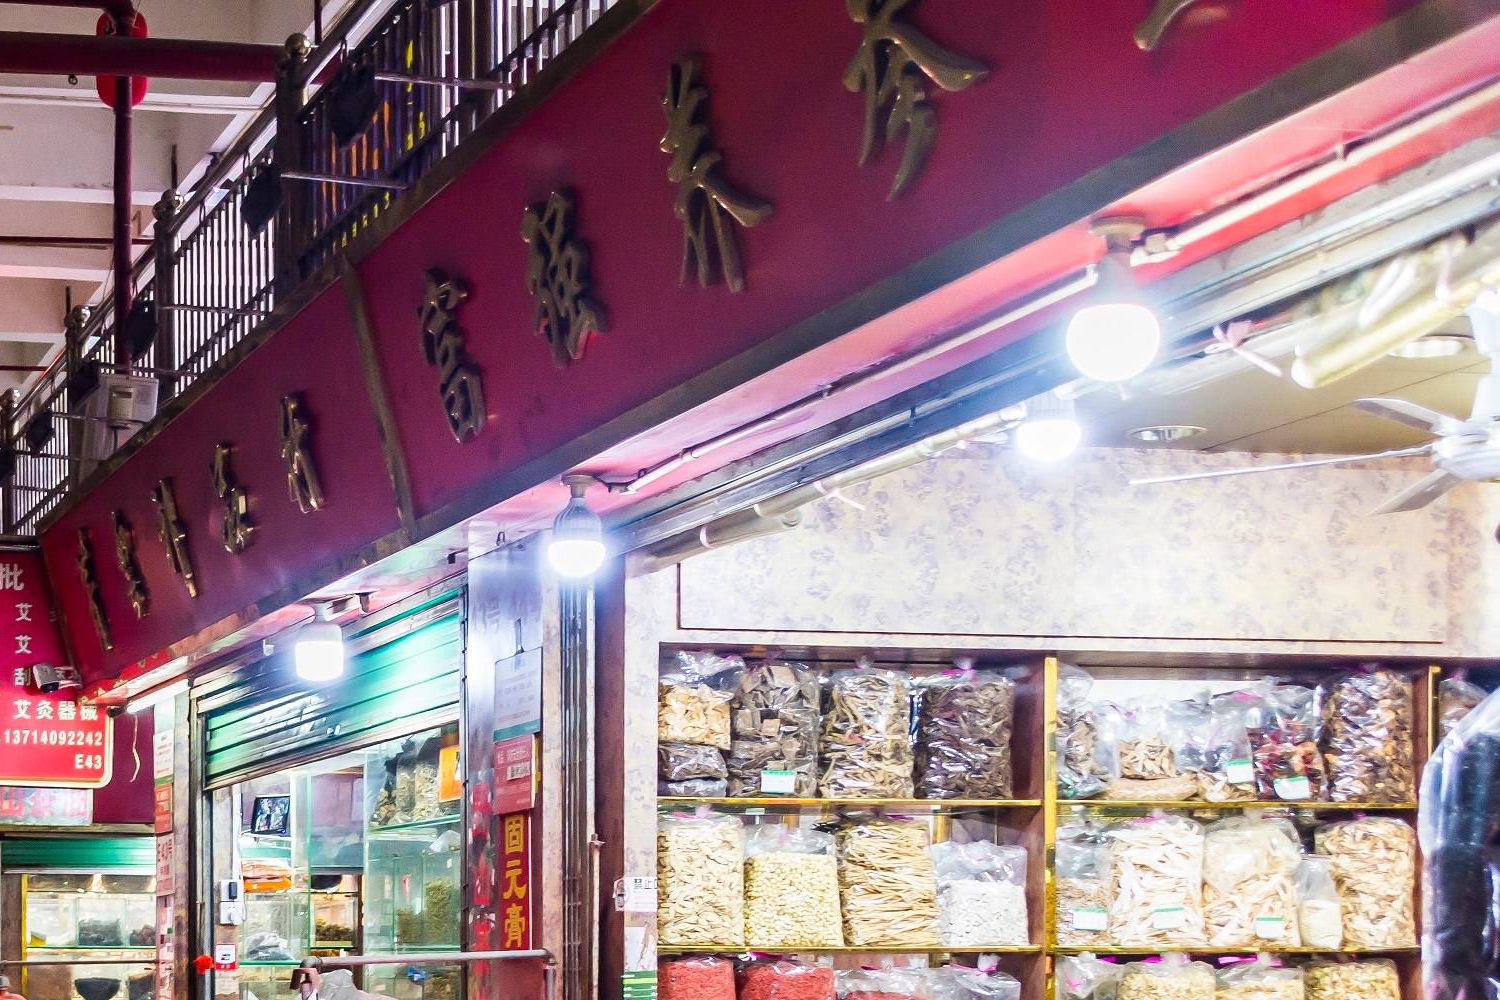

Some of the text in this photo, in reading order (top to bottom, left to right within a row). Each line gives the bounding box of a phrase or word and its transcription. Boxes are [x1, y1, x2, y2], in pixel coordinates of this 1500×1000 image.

[13, 698, 99, 721] 艾灸器械
[74, 753, 103, 770] E43
[503, 814, 528, 949] 固元膏
